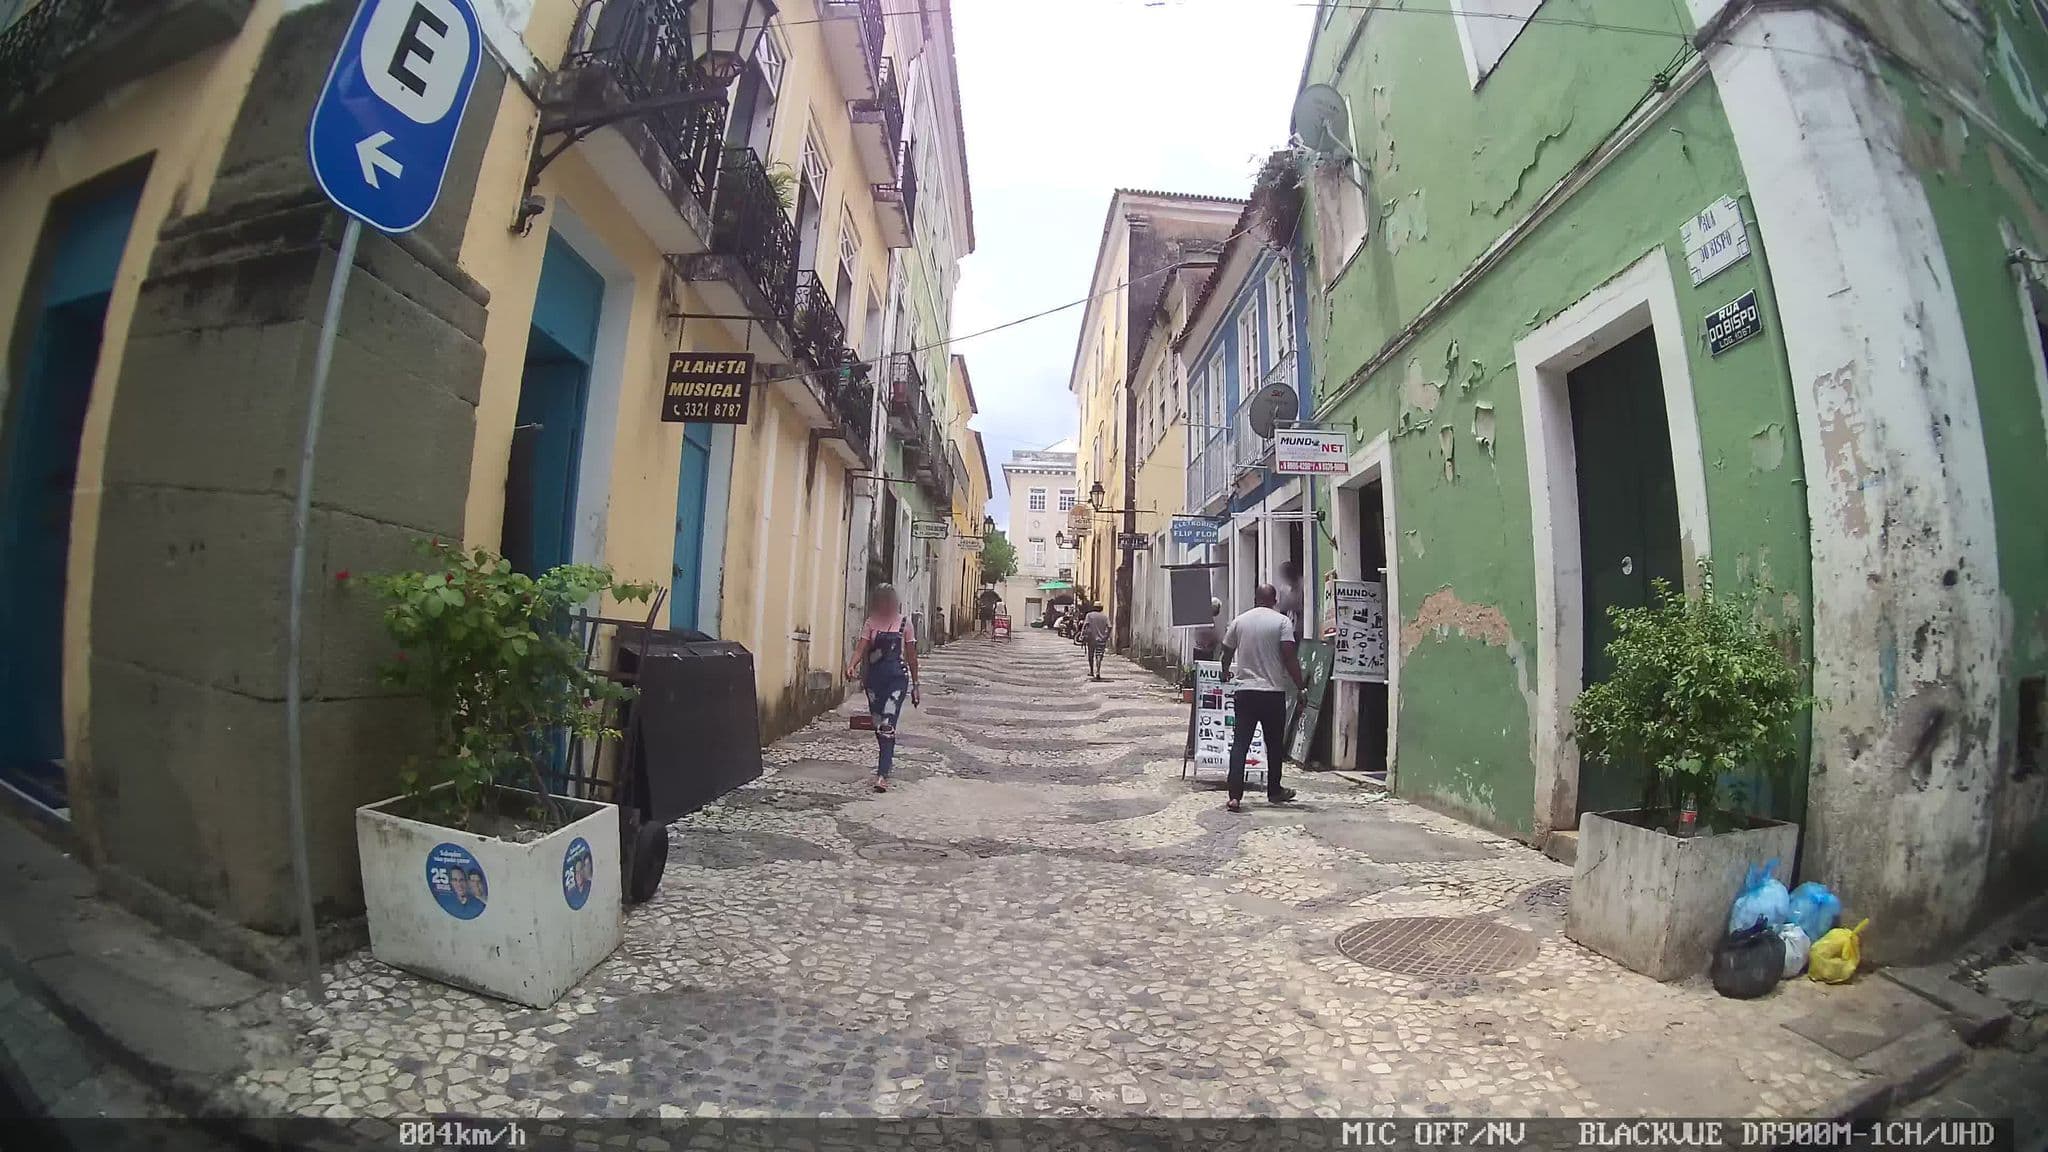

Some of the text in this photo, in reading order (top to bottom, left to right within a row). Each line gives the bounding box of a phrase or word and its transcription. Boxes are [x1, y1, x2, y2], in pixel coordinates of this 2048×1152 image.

[387, 1, 449, 97] E
[1709, 230, 1732, 257] BISPO
[1718, 302, 1740, 320] RUA
[1723, 305, 1756, 335] BISPO
[672, 360, 746, 374] PLANETA
[668, 382, 742, 398] MUSICAL
[684, 402, 741, 417] 3321 8787
[1321, 444, 1344, 453] NET
[1201, 757, 1223, 765] AQUI
[431, 868, 449, 884] 25
